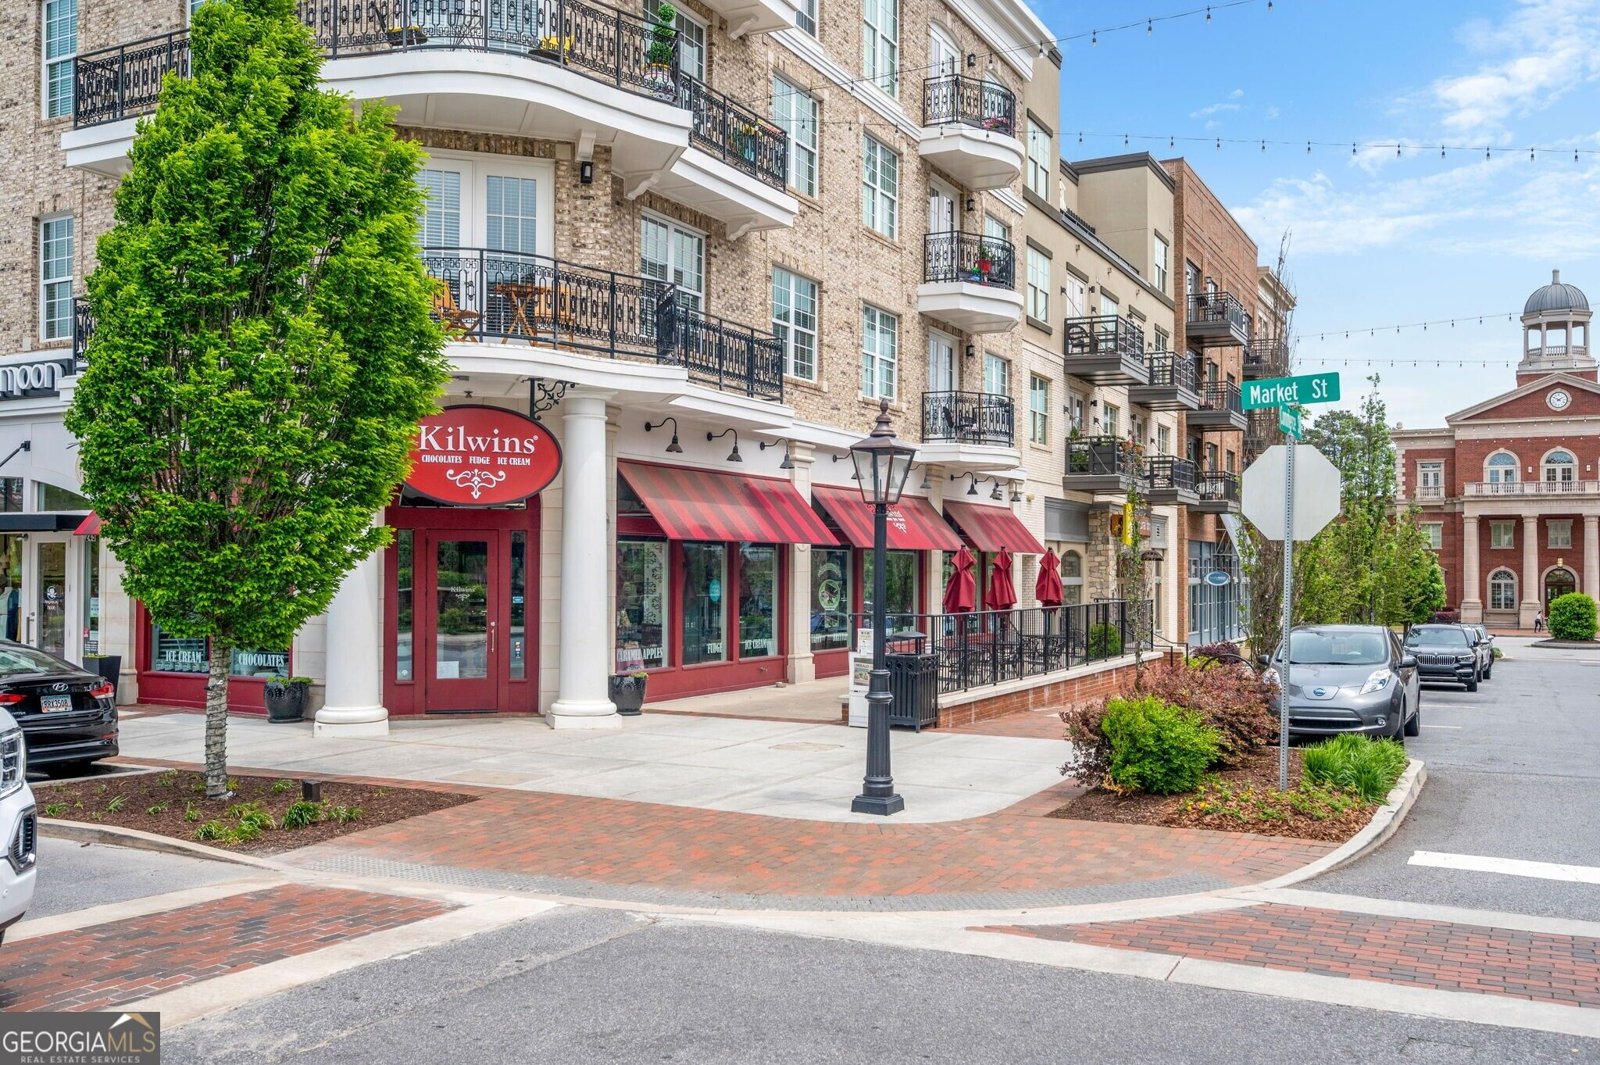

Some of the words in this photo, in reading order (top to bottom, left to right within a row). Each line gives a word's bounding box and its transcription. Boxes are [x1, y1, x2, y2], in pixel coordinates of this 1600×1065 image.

[1250, 382, 1298, 405] Market
[1312, 379, 1328, 399] St
[418, 425, 536, 454] Kilwins
[421, 454, 462, 464] CHOCOLATES
[469, 456, 490, 465] FUDGE
[497, 457, 508, 465] ICE
[509, 457, 531, 466] CREAM
[165, 650, 177, 662] ICE
[178, 651, 202, 663] CREAM
[238, 653, 285, 667] CHOCOLATES
[642, 647, 663, 660] APPLES
